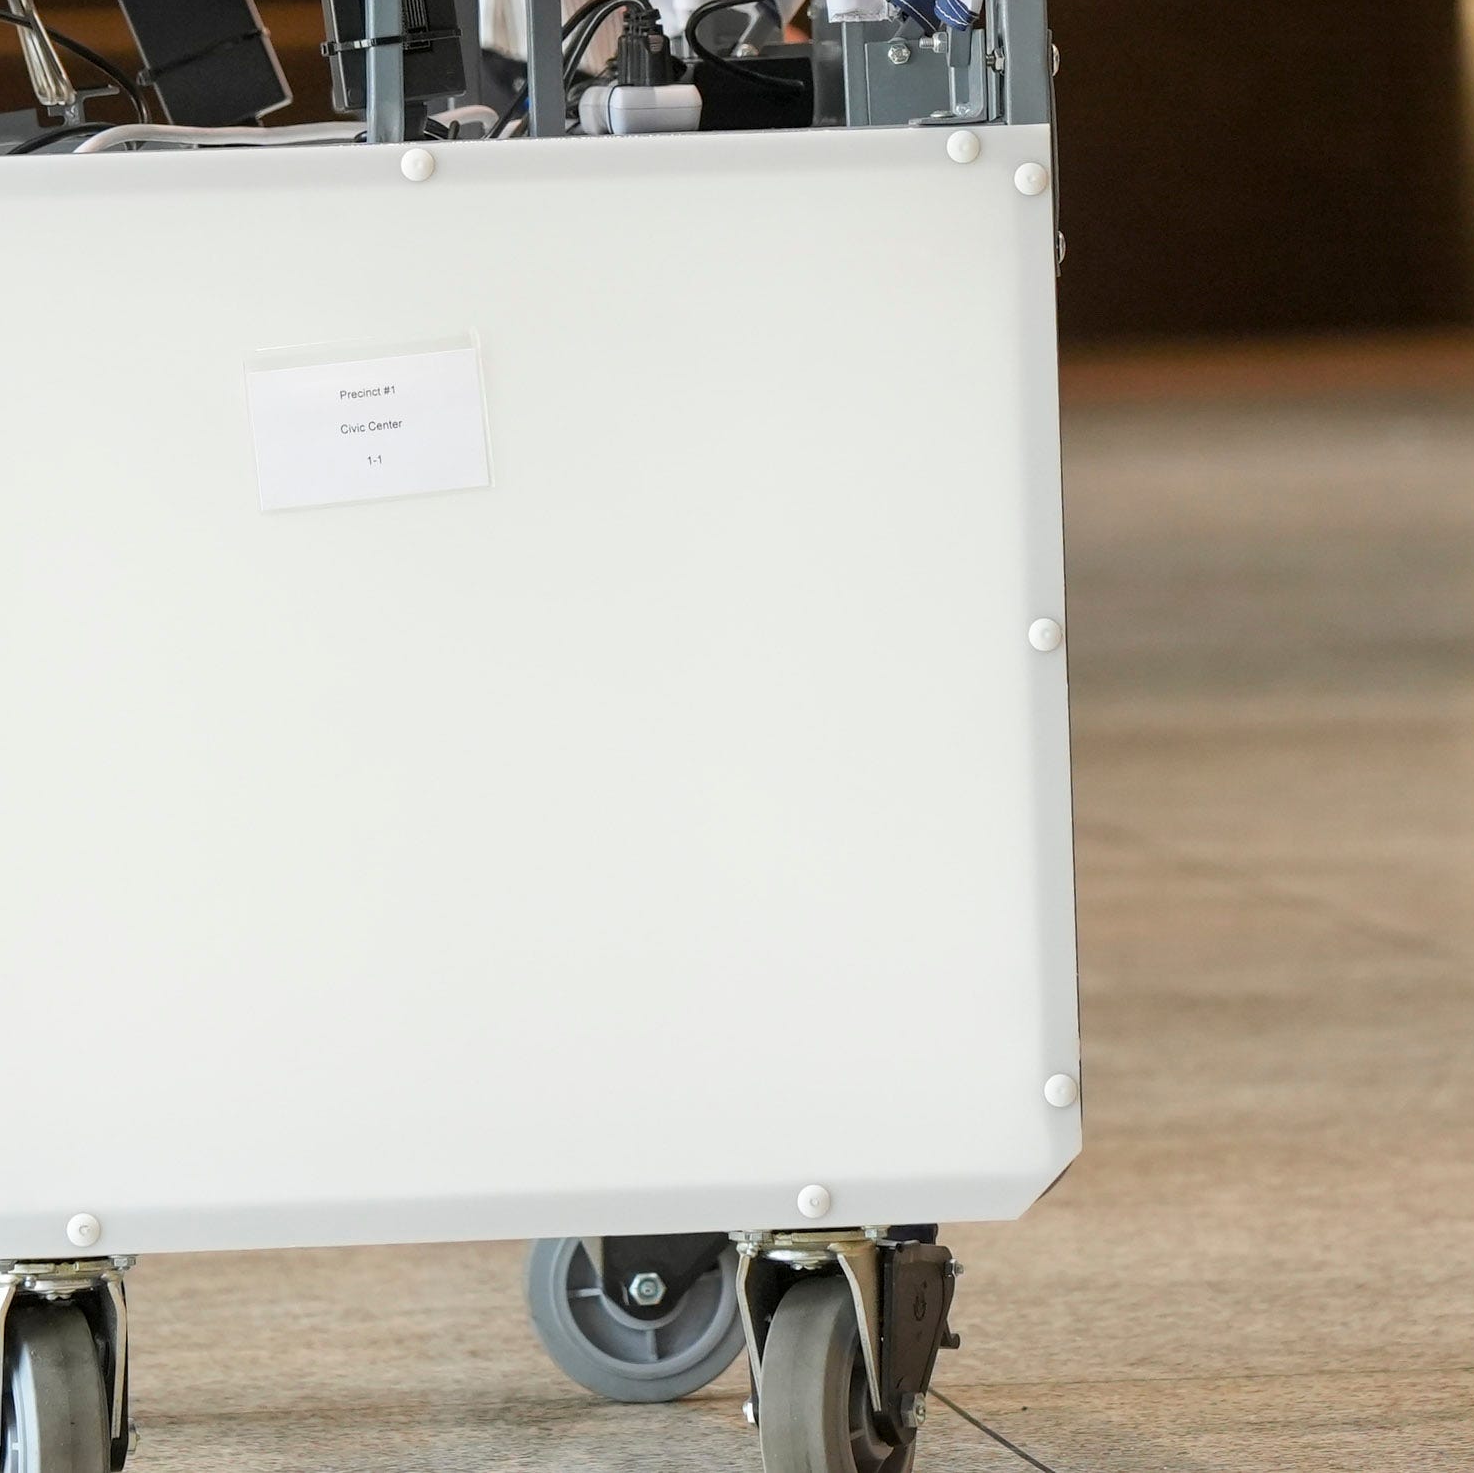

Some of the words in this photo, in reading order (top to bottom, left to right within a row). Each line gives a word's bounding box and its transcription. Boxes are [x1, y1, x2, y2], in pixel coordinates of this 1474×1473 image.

[339, 387, 381, 400] Precinct
[383, 386, 396, 395] #1
[340, 423, 366, 434] Civic
[368, 419, 403, 432] Center
[367, 455, 382, 466] 1-1
